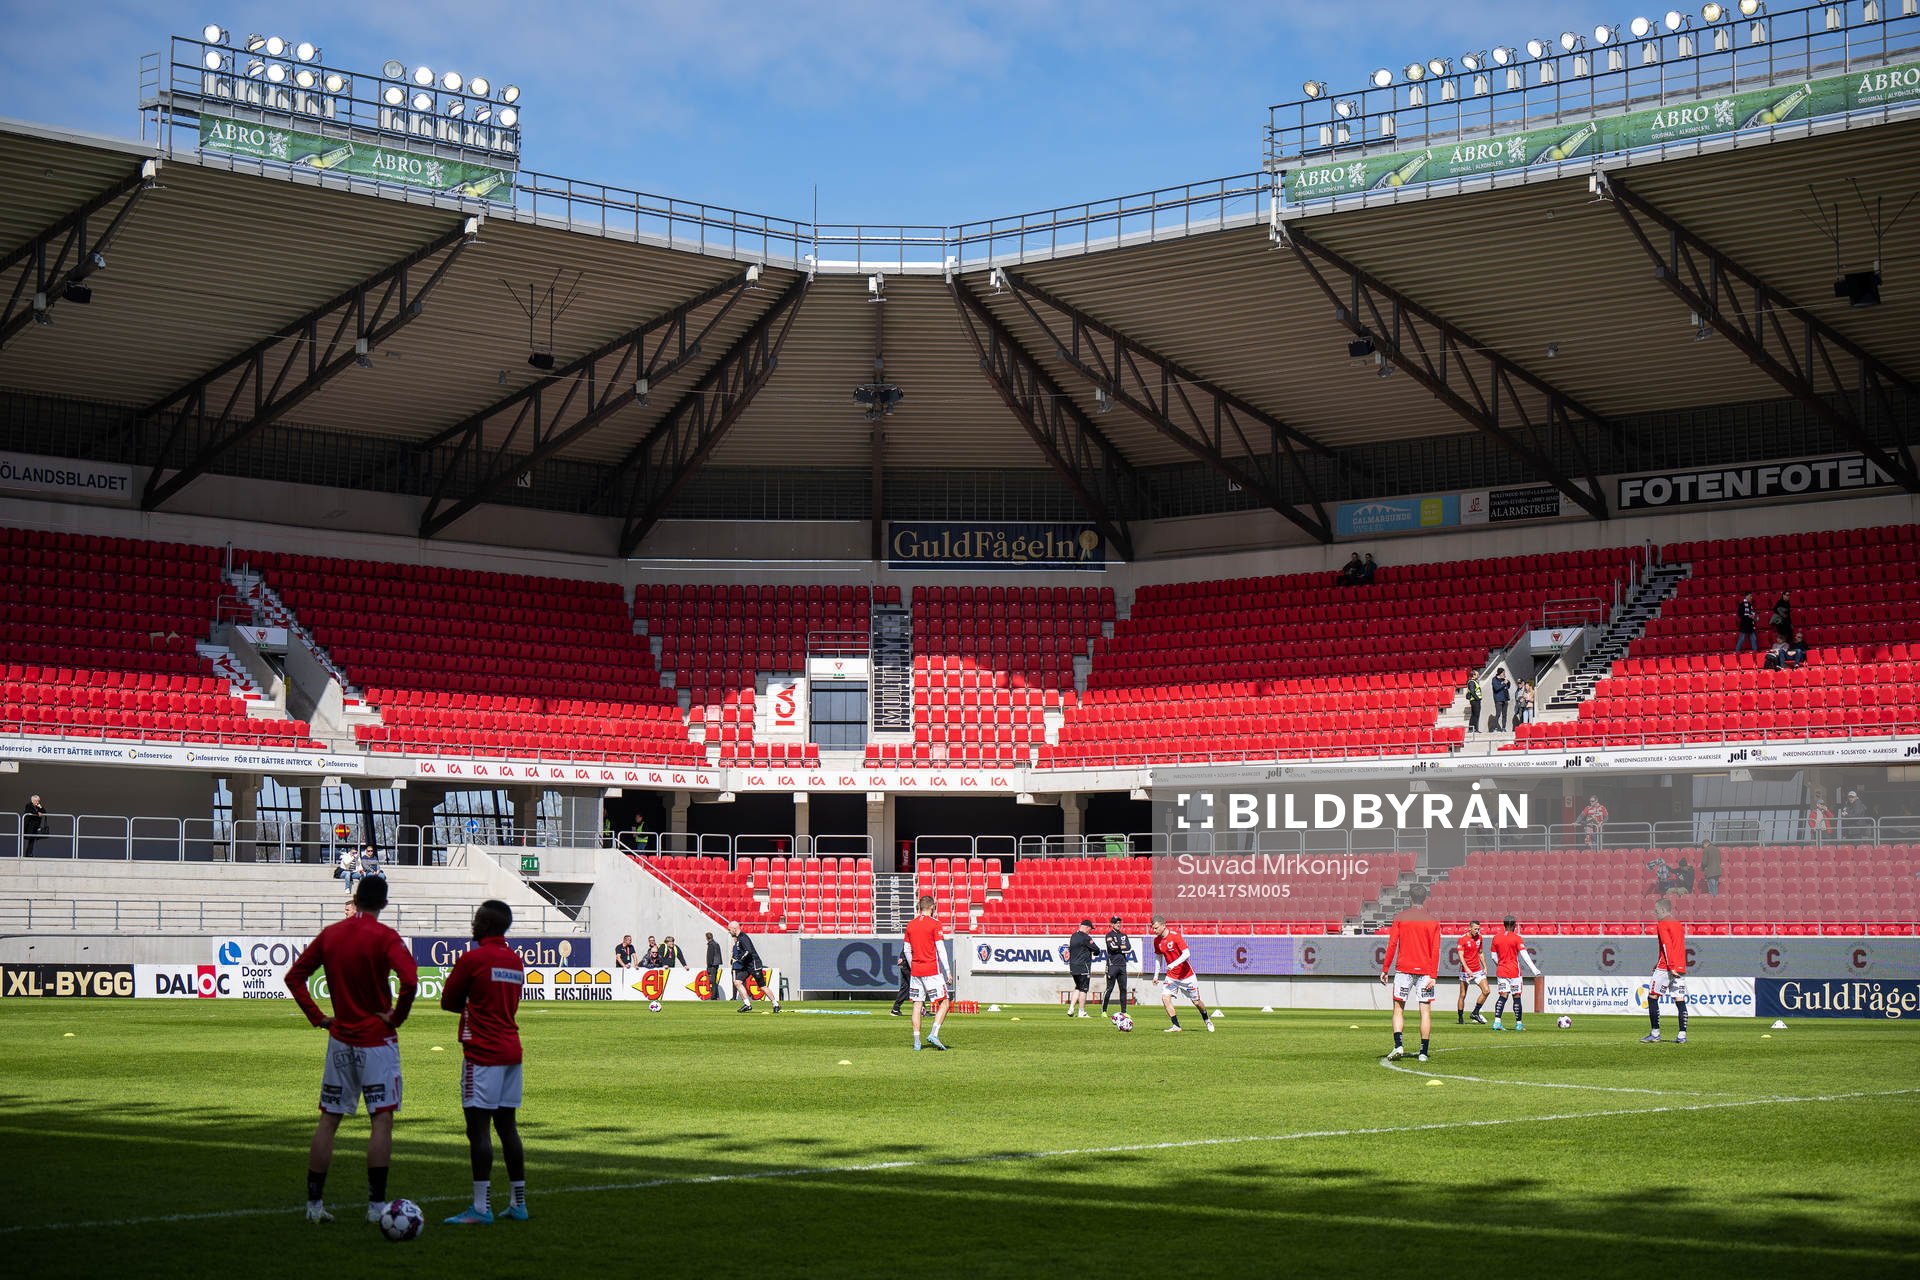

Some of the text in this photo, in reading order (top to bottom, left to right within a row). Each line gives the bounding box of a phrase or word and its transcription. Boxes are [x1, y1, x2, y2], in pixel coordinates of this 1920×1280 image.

[1858, 68, 1920, 94] ÅBRO
[1651, 106, 1709, 130] ÅBRO
[210, 120, 265, 146] ÅBRO
[372, 150, 422, 175] ÅBRO
[1450, 142, 1503, 164] ÅBRO
[1294, 167, 1344, 188] ÅBRO
[0, 461, 128, 490] ÖLANDSBLADET
[1490, 502, 1559, 518] ALARMSTREET
[894, 530, 1077, 565] GuldFågeln
[775, 683, 796, 726] ICA
[38, 744, 52, 754] FÖR
[68, 746, 93, 756] BÄTTRE
[94, 749, 123, 758] INTRYCK
[234, 754, 248, 764] FÖR
[248, 756, 260, 764] ETT
[262, 756, 284, 765] BÄTTRE
[286, 758, 312, 766] INTRYCK
[421, 762, 709, 784] ICA ICA ICA ICA ICA ICA ICA ICA ICA ICA ICA ICA
[748, 776, 1008, 786] ICA ICA ICA ICA ICA ICA ICA ICA ICA
[994, 949, 1053, 963] SCANIA
[242, 966, 272, 977] Doors
[7, 970, 133, 996] XL-BYGG
[156, 972, 230, 995] DALOC
[243, 978, 264, 988] with
[554, 985, 612, 1000] EKSJÖHUS
[1548, 984, 1629, 996] VI HÅLLER PÅ KFF
[1561, 998, 1582, 1008] skyltar
[1584, 998, 1591, 1006] vi
[1592, 998, 1612, 1008] gärna
[1779, 982, 1920, 1018] GuldFåge
